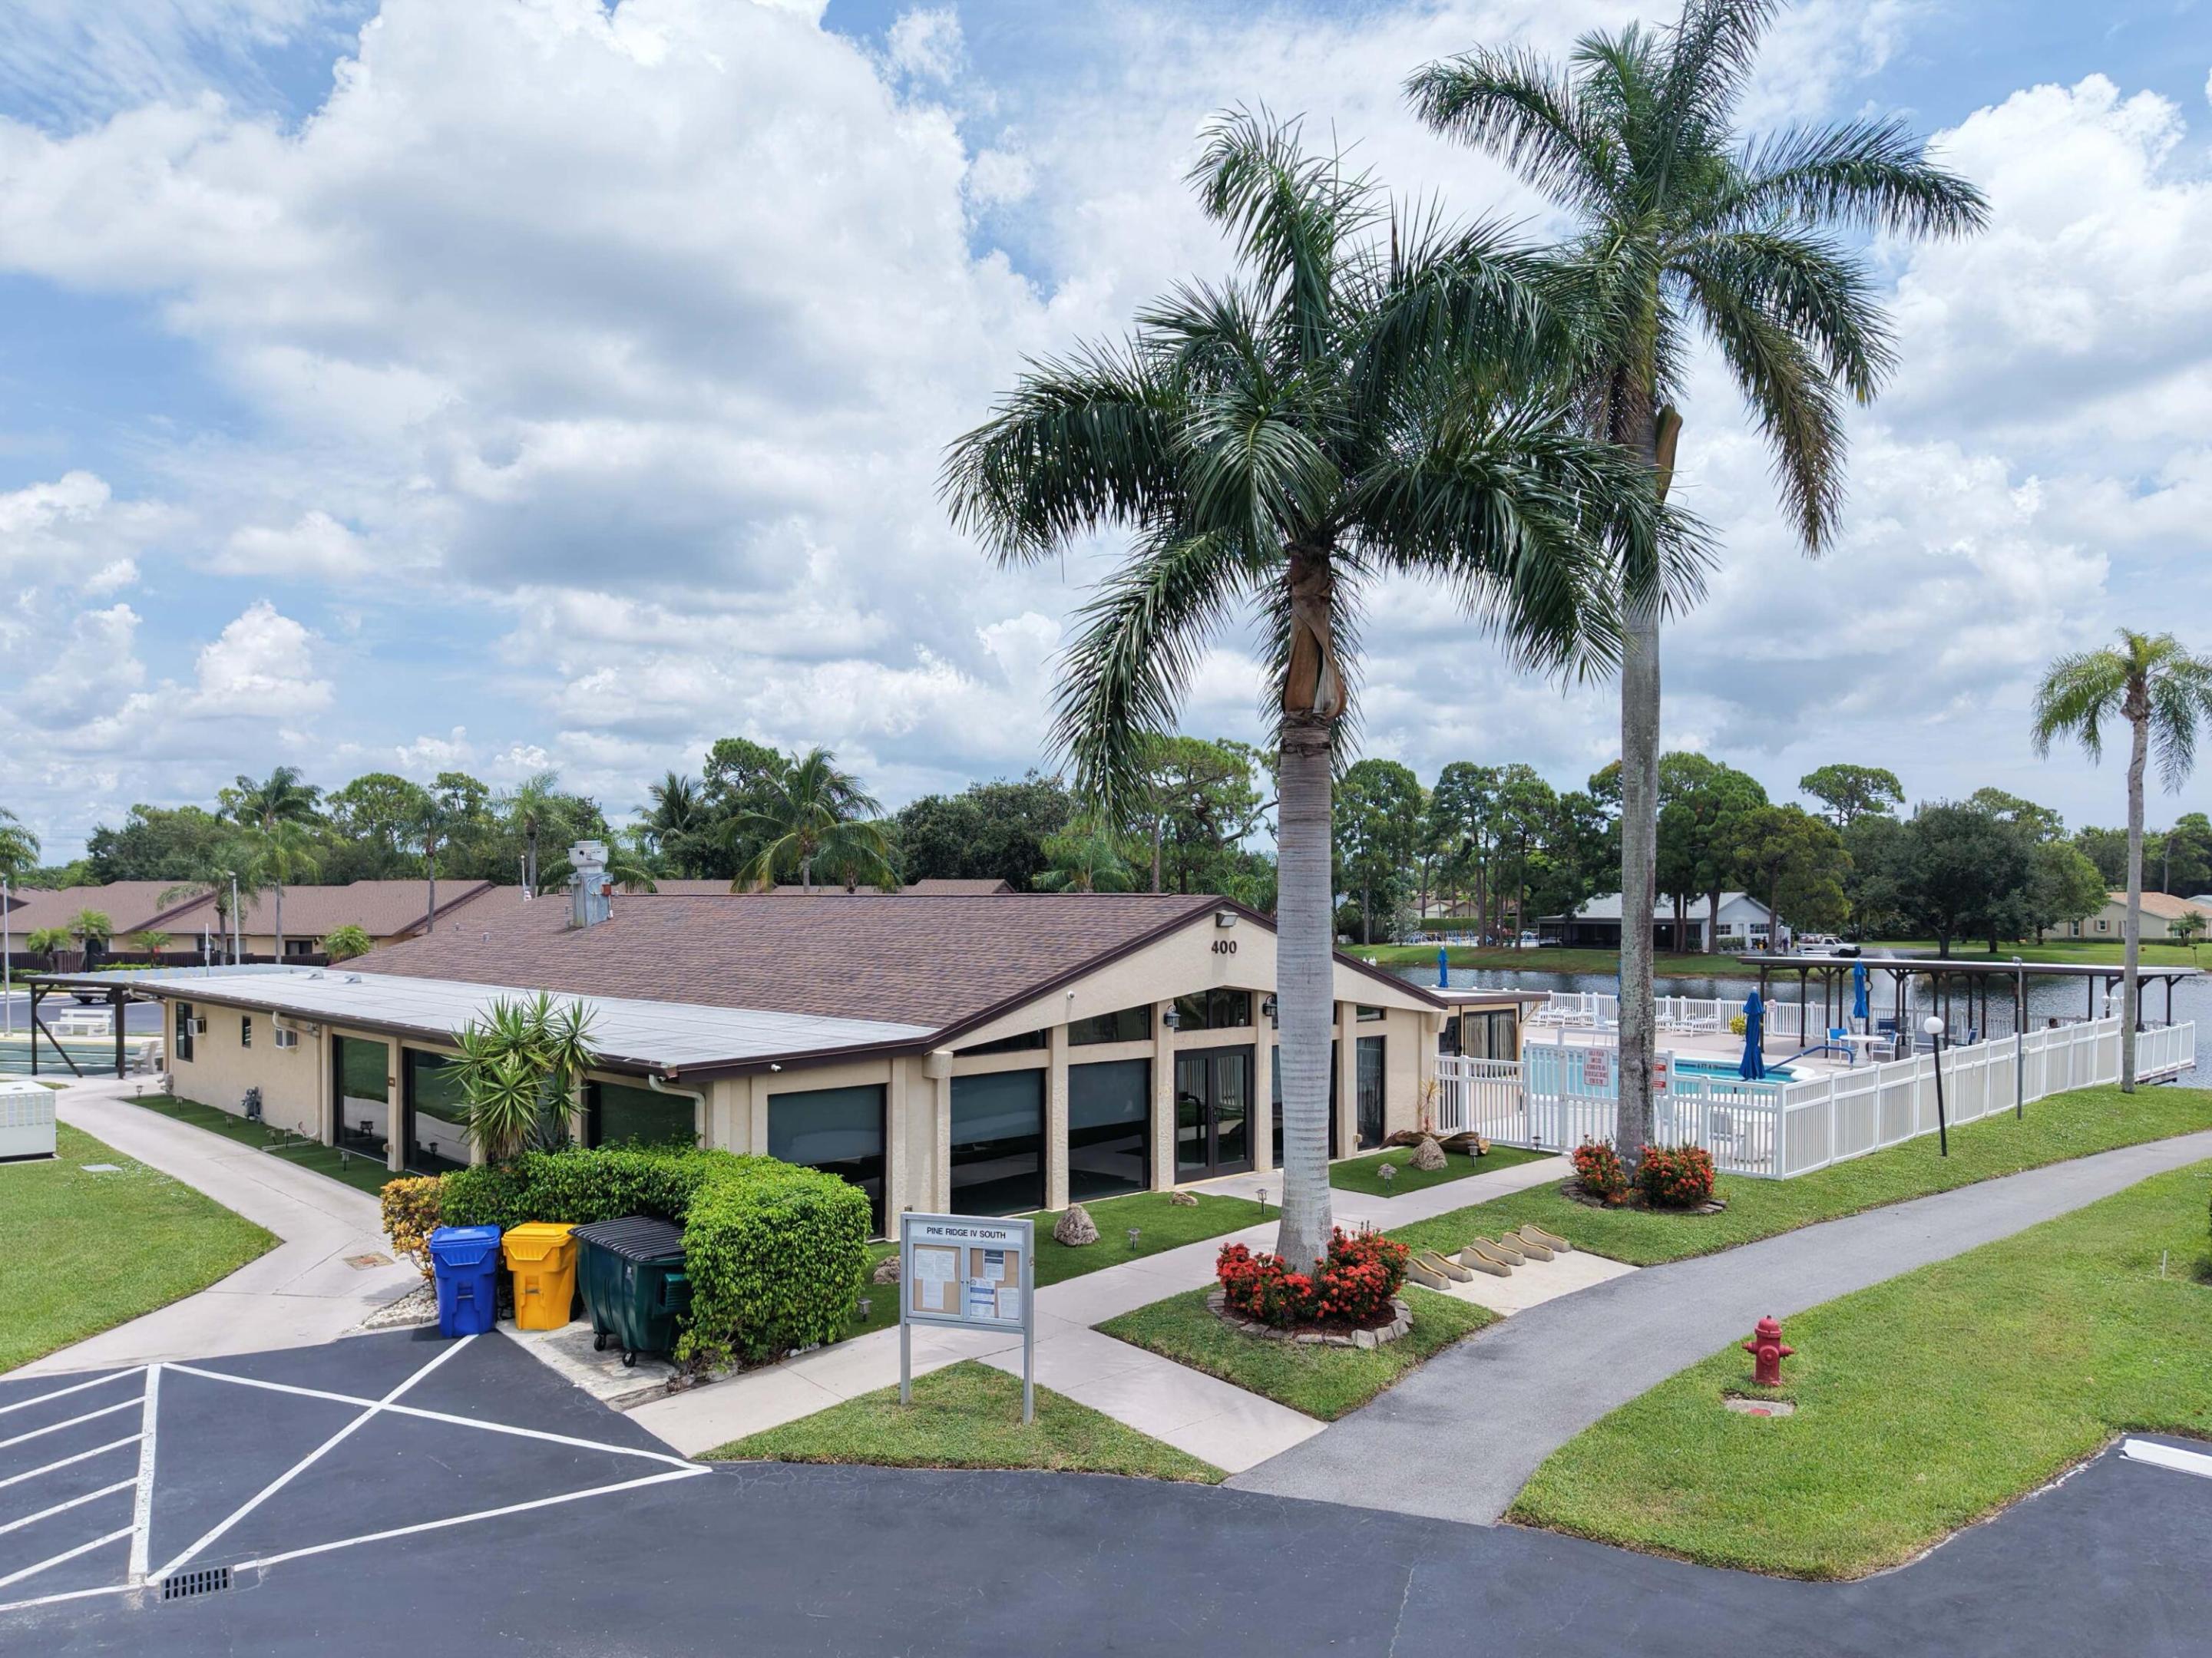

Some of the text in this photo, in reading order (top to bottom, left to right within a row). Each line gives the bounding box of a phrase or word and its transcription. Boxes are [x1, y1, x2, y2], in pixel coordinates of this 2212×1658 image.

[1212, 940, 1237, 953] 400
[927, 1227, 943, 1235] PINE
[945, 1228, 968, 1237] RIDGE
[980, 1230, 1006, 1239] SOUTH
